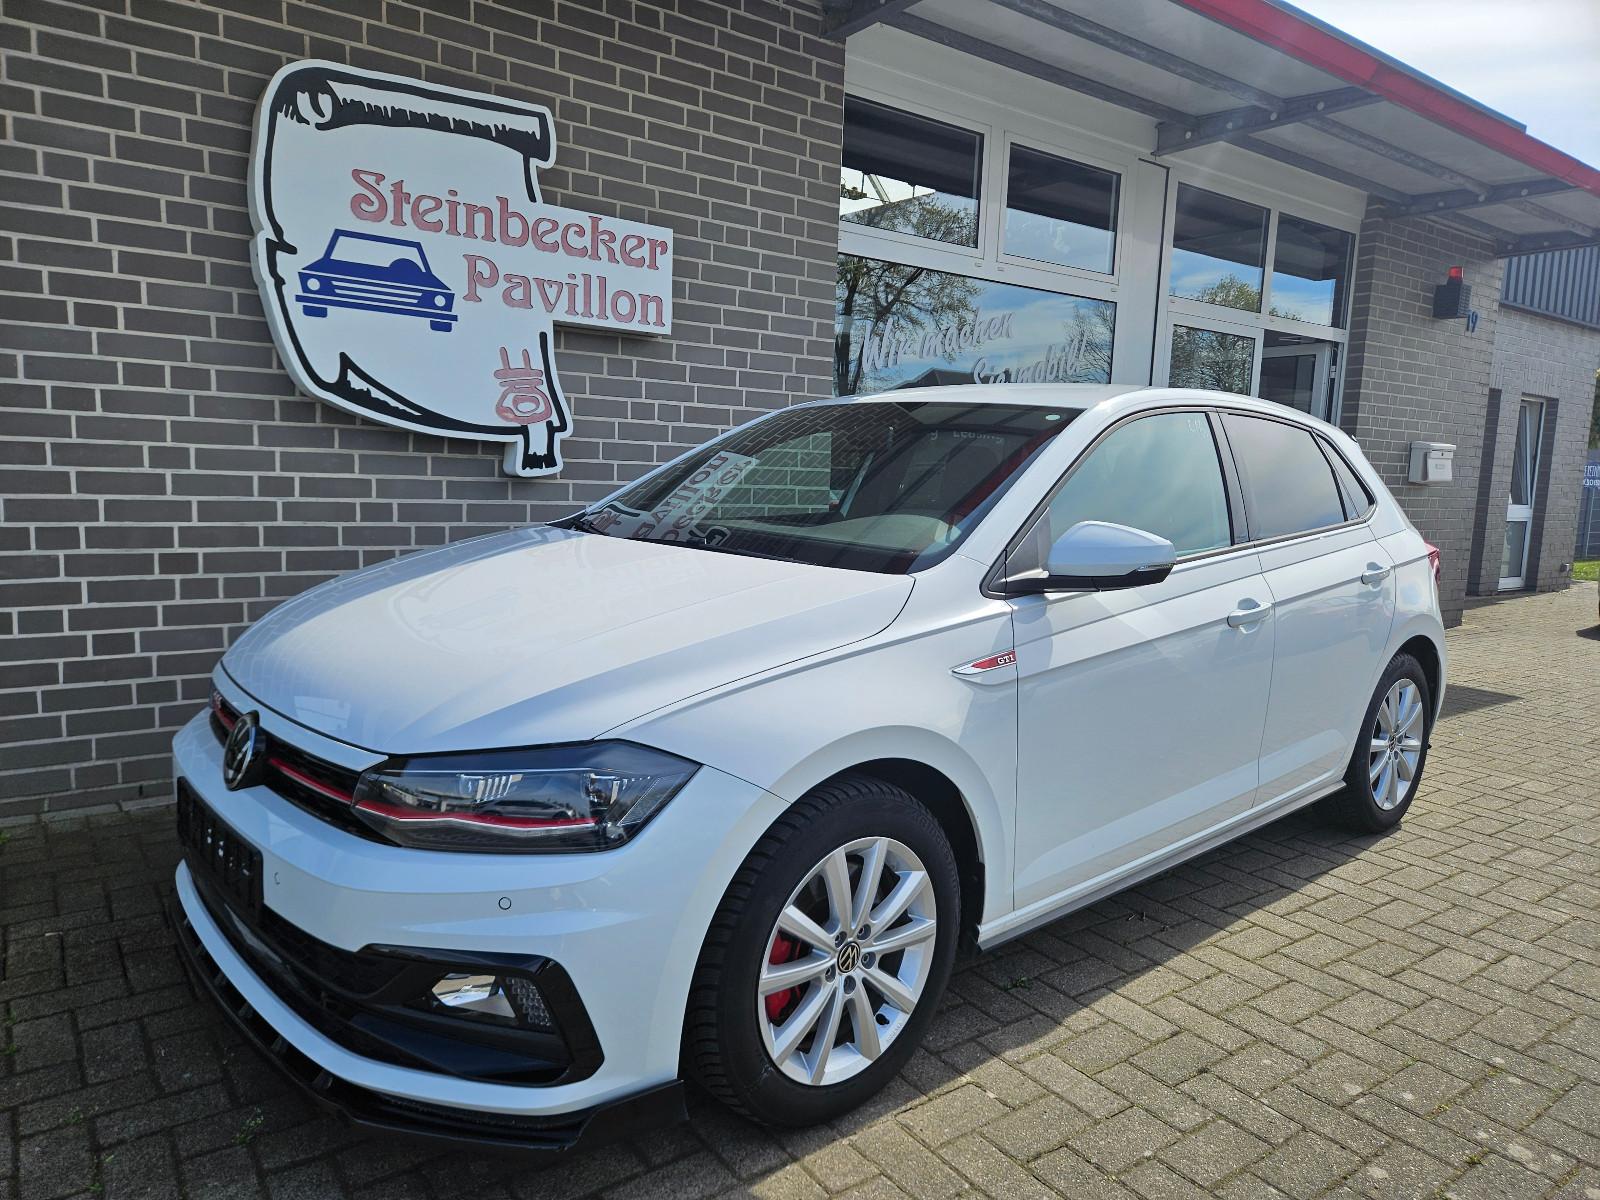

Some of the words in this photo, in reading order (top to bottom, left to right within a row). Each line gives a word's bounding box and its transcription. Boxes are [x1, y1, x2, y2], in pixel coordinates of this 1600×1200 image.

[350, 168, 668, 271] Steinbecker
[463, 254, 667, 328] Pavillon
[862, 316, 911, 372] Wir
[918, 306, 1016, 359] machen
[997, 654, 1015, 665] GTI
